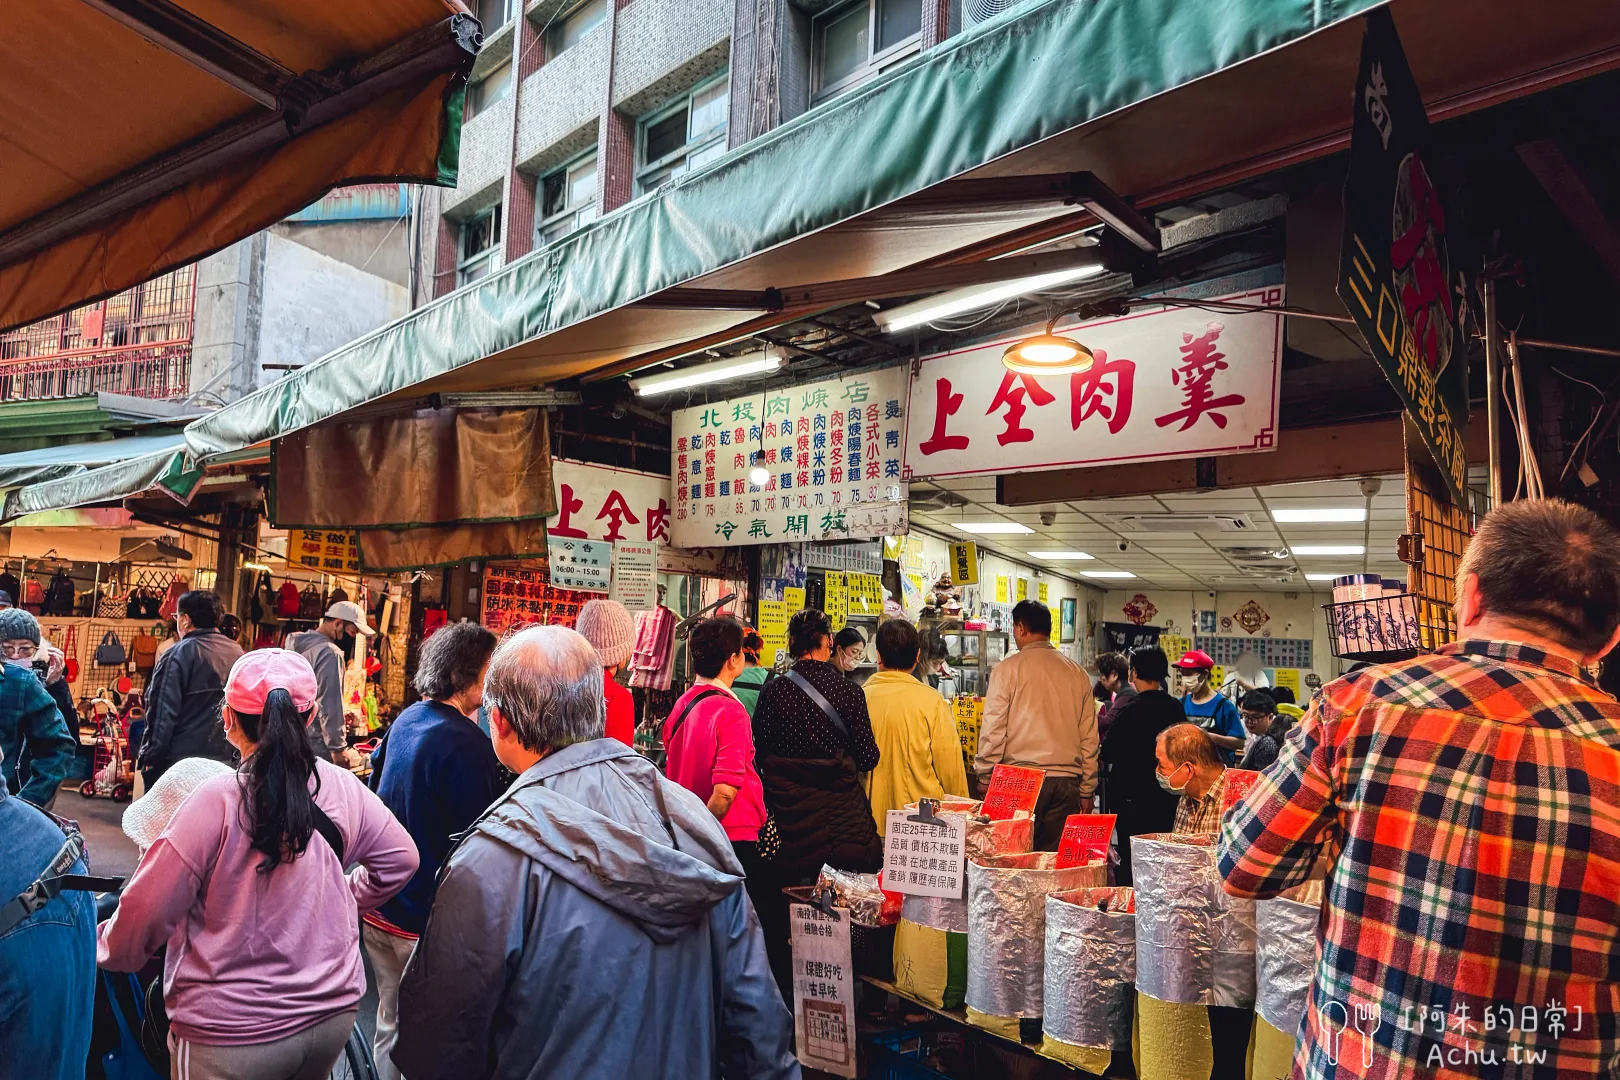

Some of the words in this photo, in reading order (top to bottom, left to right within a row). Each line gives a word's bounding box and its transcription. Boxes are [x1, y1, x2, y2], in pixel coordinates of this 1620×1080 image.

[919, 321, 1246, 456] 上全肉羹
[866, 403, 880, 480] 各式小菜
[885, 399, 900, 478] 燙青菜
[691, 434, 701, 500] 乾意麵
[720, 430, 730, 497] 乾麵
[734, 427, 745, 495] 魯肉飯
[768, 497, 774, 509] 70
[782, 496, 789, 508] 70
[799, 495, 807, 507] 70
[815, 493, 823, 505] 70
[832, 491, 840, 503] 70
[852, 489, 860, 502] 75
[706, 504, 714, 516] 75
[735, 502, 743, 514] 35
[752, 499, 760, 511] 70
[714, 512, 848, 541] 冷氣開放
[563, 541, 593, 553] 公告
[559, 555, 598, 565] 營業時間
[955, 545, 969, 581] 點餐區
[556, 565, 574, 573] 06:00
[583, 568, 600, 576] 15:00
[958, 701, 974, 709] 新品
[957, 709, 974, 717] 上市
[993, 776, 1035, 792] 南投精選
[991, 796, 1020, 811] 綠茶
[891, 822, 958, 839] 固定25年老攤位
[1063, 825, 1107, 840] 南投清香
[891, 837, 908, 851] 品質
[911, 840, 959, 856] 價格不欺騙
[1062, 847, 1096, 861] 高山茶
[890, 853, 907, 867] 台灣
[910, 856, 958, 873] 在地農產品
[888, 869, 906, 883] 產銷
[908, 872, 957, 890] 履歷有保障
[804, 924, 832, 937] 檢驗合格
[805, 960, 843, 981] 保證好吃
[809, 982, 838, 1000] 古早味
